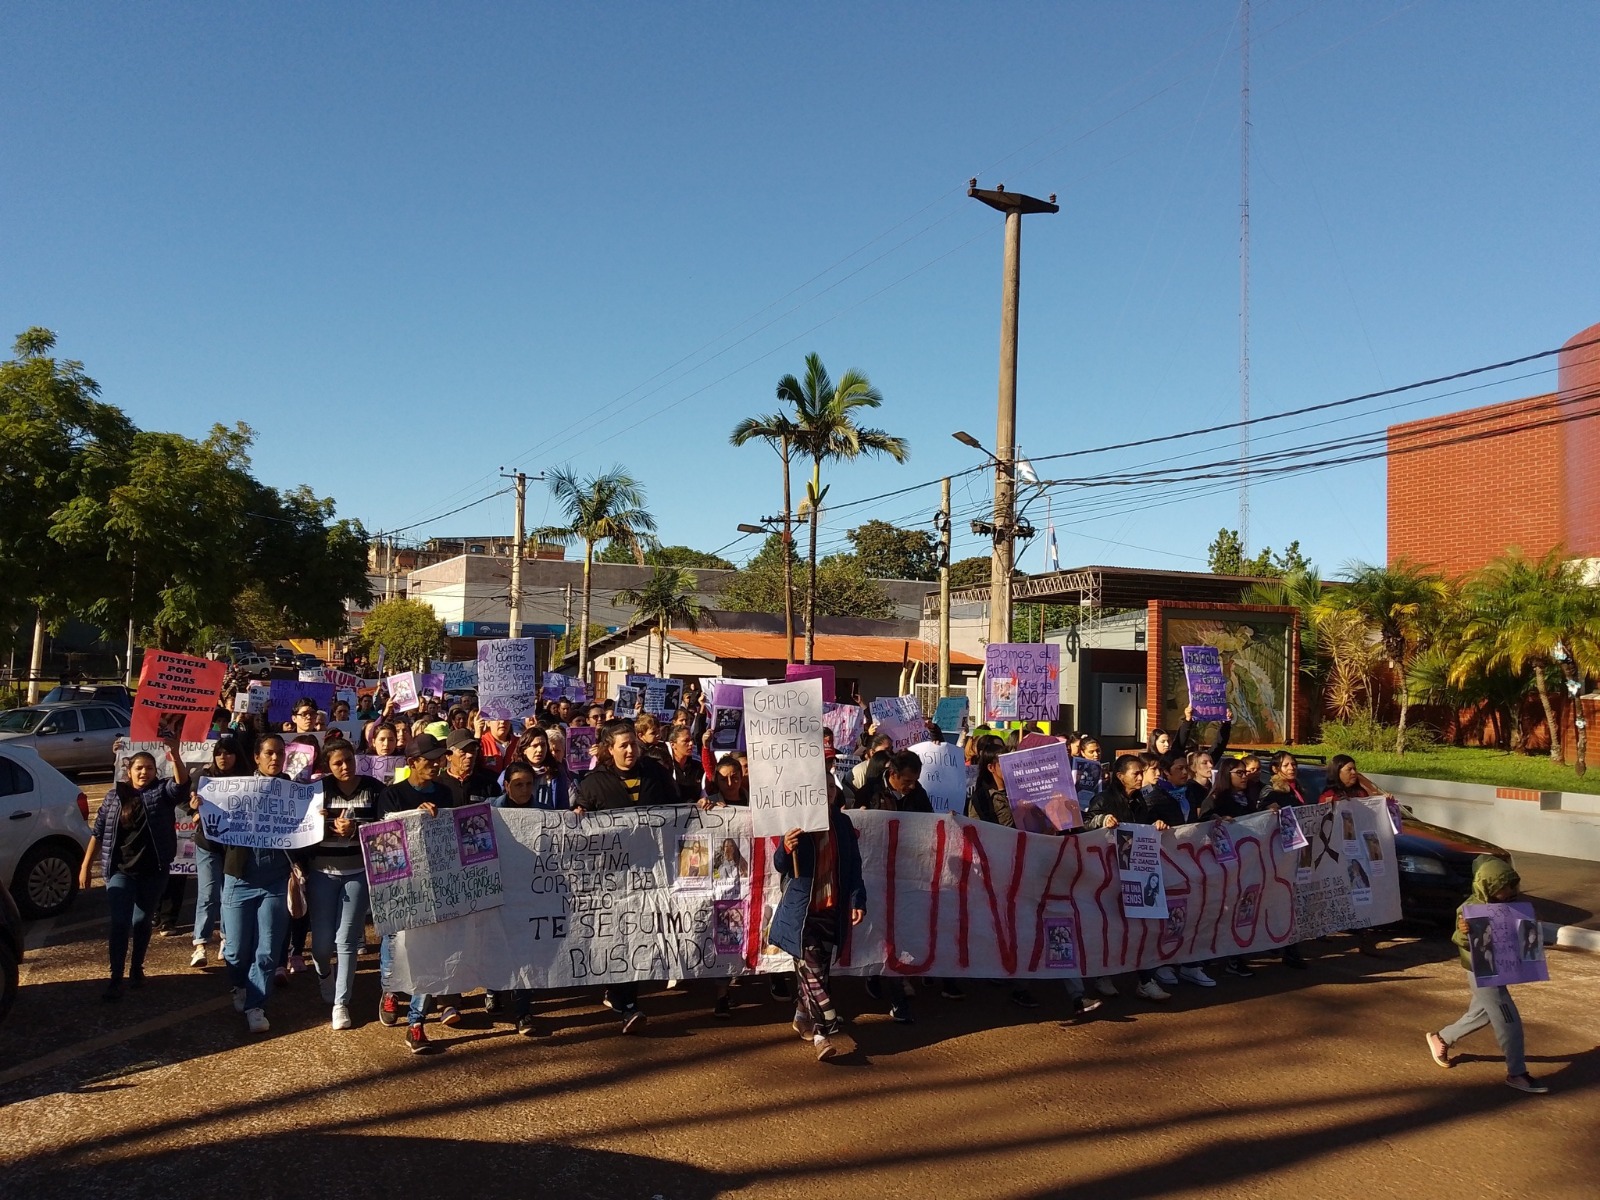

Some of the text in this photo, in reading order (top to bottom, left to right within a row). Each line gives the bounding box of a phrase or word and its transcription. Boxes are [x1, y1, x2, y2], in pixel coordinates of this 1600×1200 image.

[157, 654, 207, 669] JUSTICIA
[167, 665, 192, 675] POR
[158, 672, 196, 685] TODAS
[147, 680, 216, 696] LAS MUJERES
[167, 694, 198, 704] NIÑAS
[753, 690, 810, 712] GRUPO
[1018, 690, 1039, 705] NO
[1018, 704, 1059, 720] ESTAN
[749, 715, 821, 736] MUJERES
[748, 738, 820, 761] FUERTES
[919, 752, 961, 770] USTICIA
[1041, 777, 1059, 786] FALTE
[289, 783, 315, 800] POR
[258, 814, 270, 822] DE
[254, 823, 271, 833] LAS
[533, 832, 622, 854] CANDELA
[531, 870, 655, 894] CORREAS DE
[1130, 884, 1141, 894] UNA
[562, 892, 614, 914] MELO
[886, 819, 1087, 977] UNA
[388, 905, 418, 924] TODAS
[424, 898, 443, 912] LAS
[446, 894, 460, 908] QUE
[474, 889, 483, 898] NO
[528, 909, 708, 940] TE SEGUIMOS
